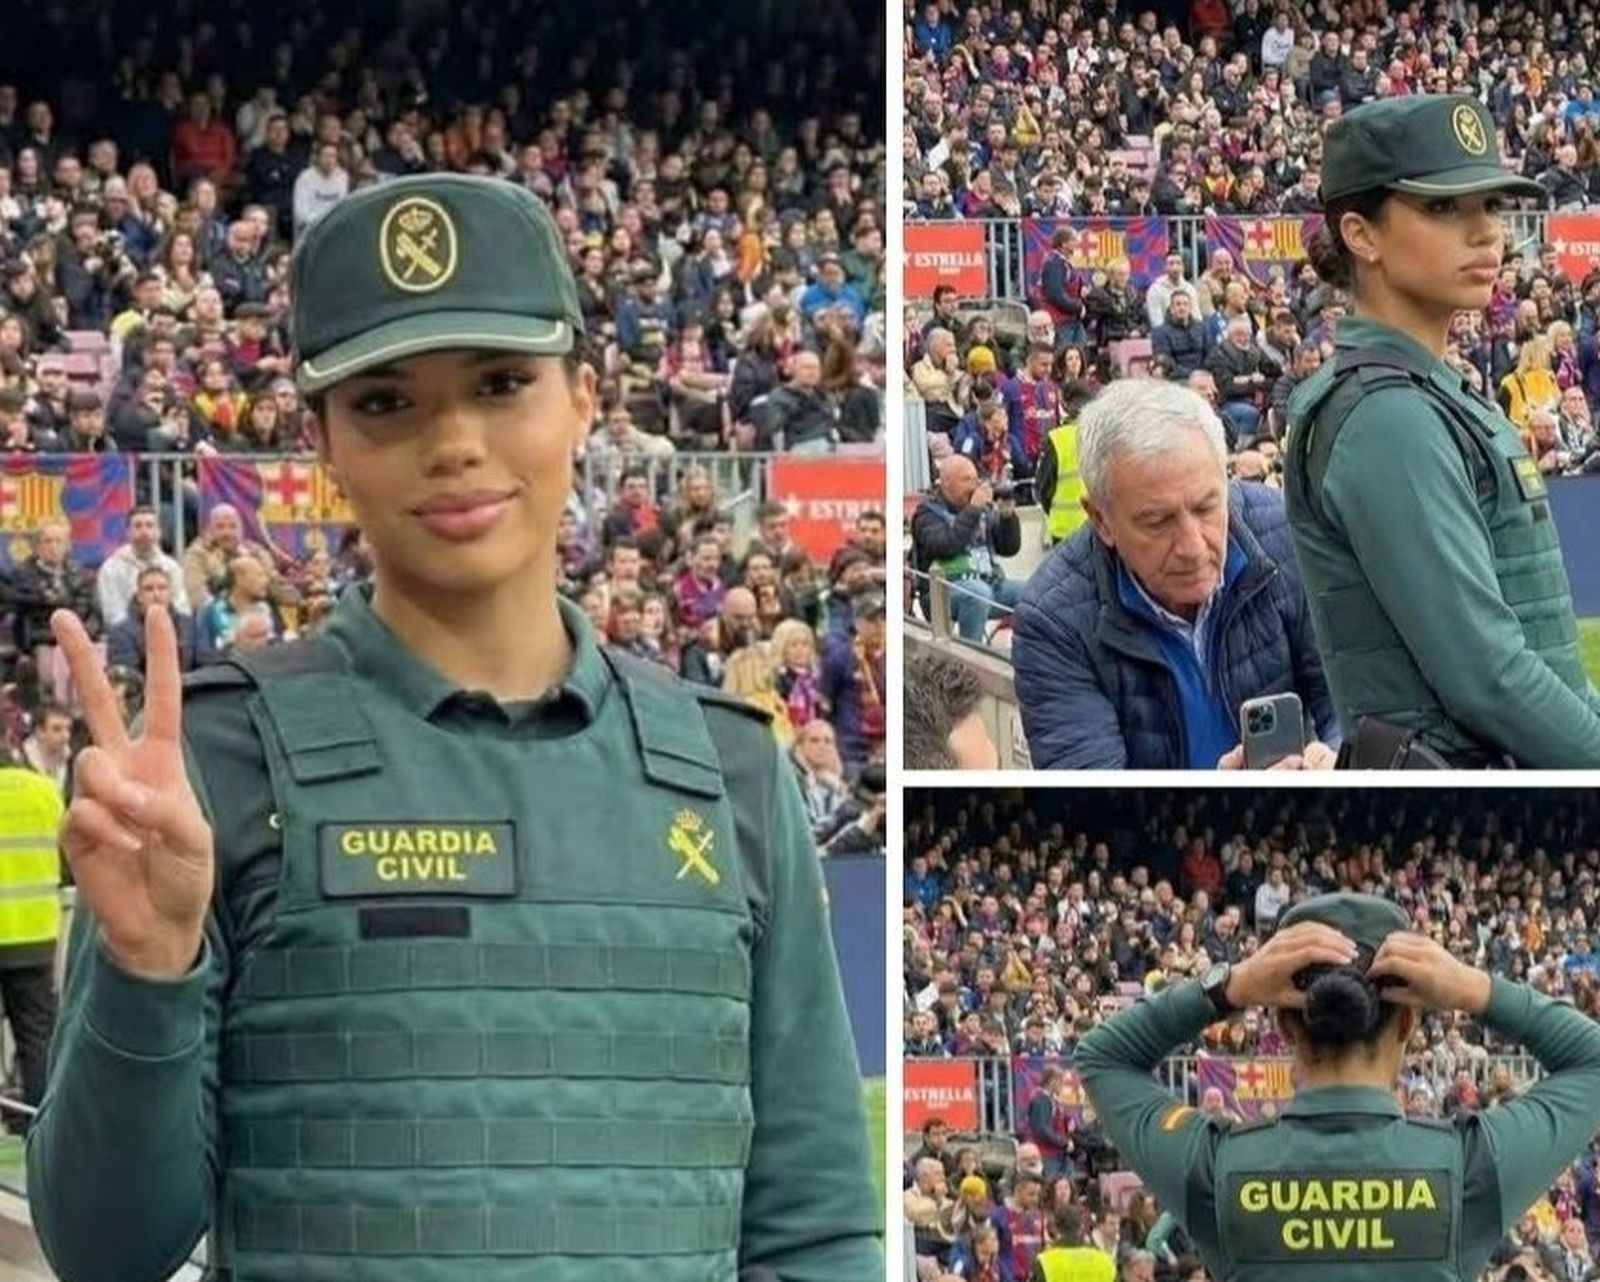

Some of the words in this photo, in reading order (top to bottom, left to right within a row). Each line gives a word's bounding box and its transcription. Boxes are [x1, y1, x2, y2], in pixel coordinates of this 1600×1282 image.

[914, 252, 984, 267] ESTRELLA
[341, 829, 498, 854] GUARDIA
[376, 855, 467, 880] CIVIL
[1239, 1178, 1437, 1212] GUARDIA
[1281, 1217, 1395, 1249] CIVIL
